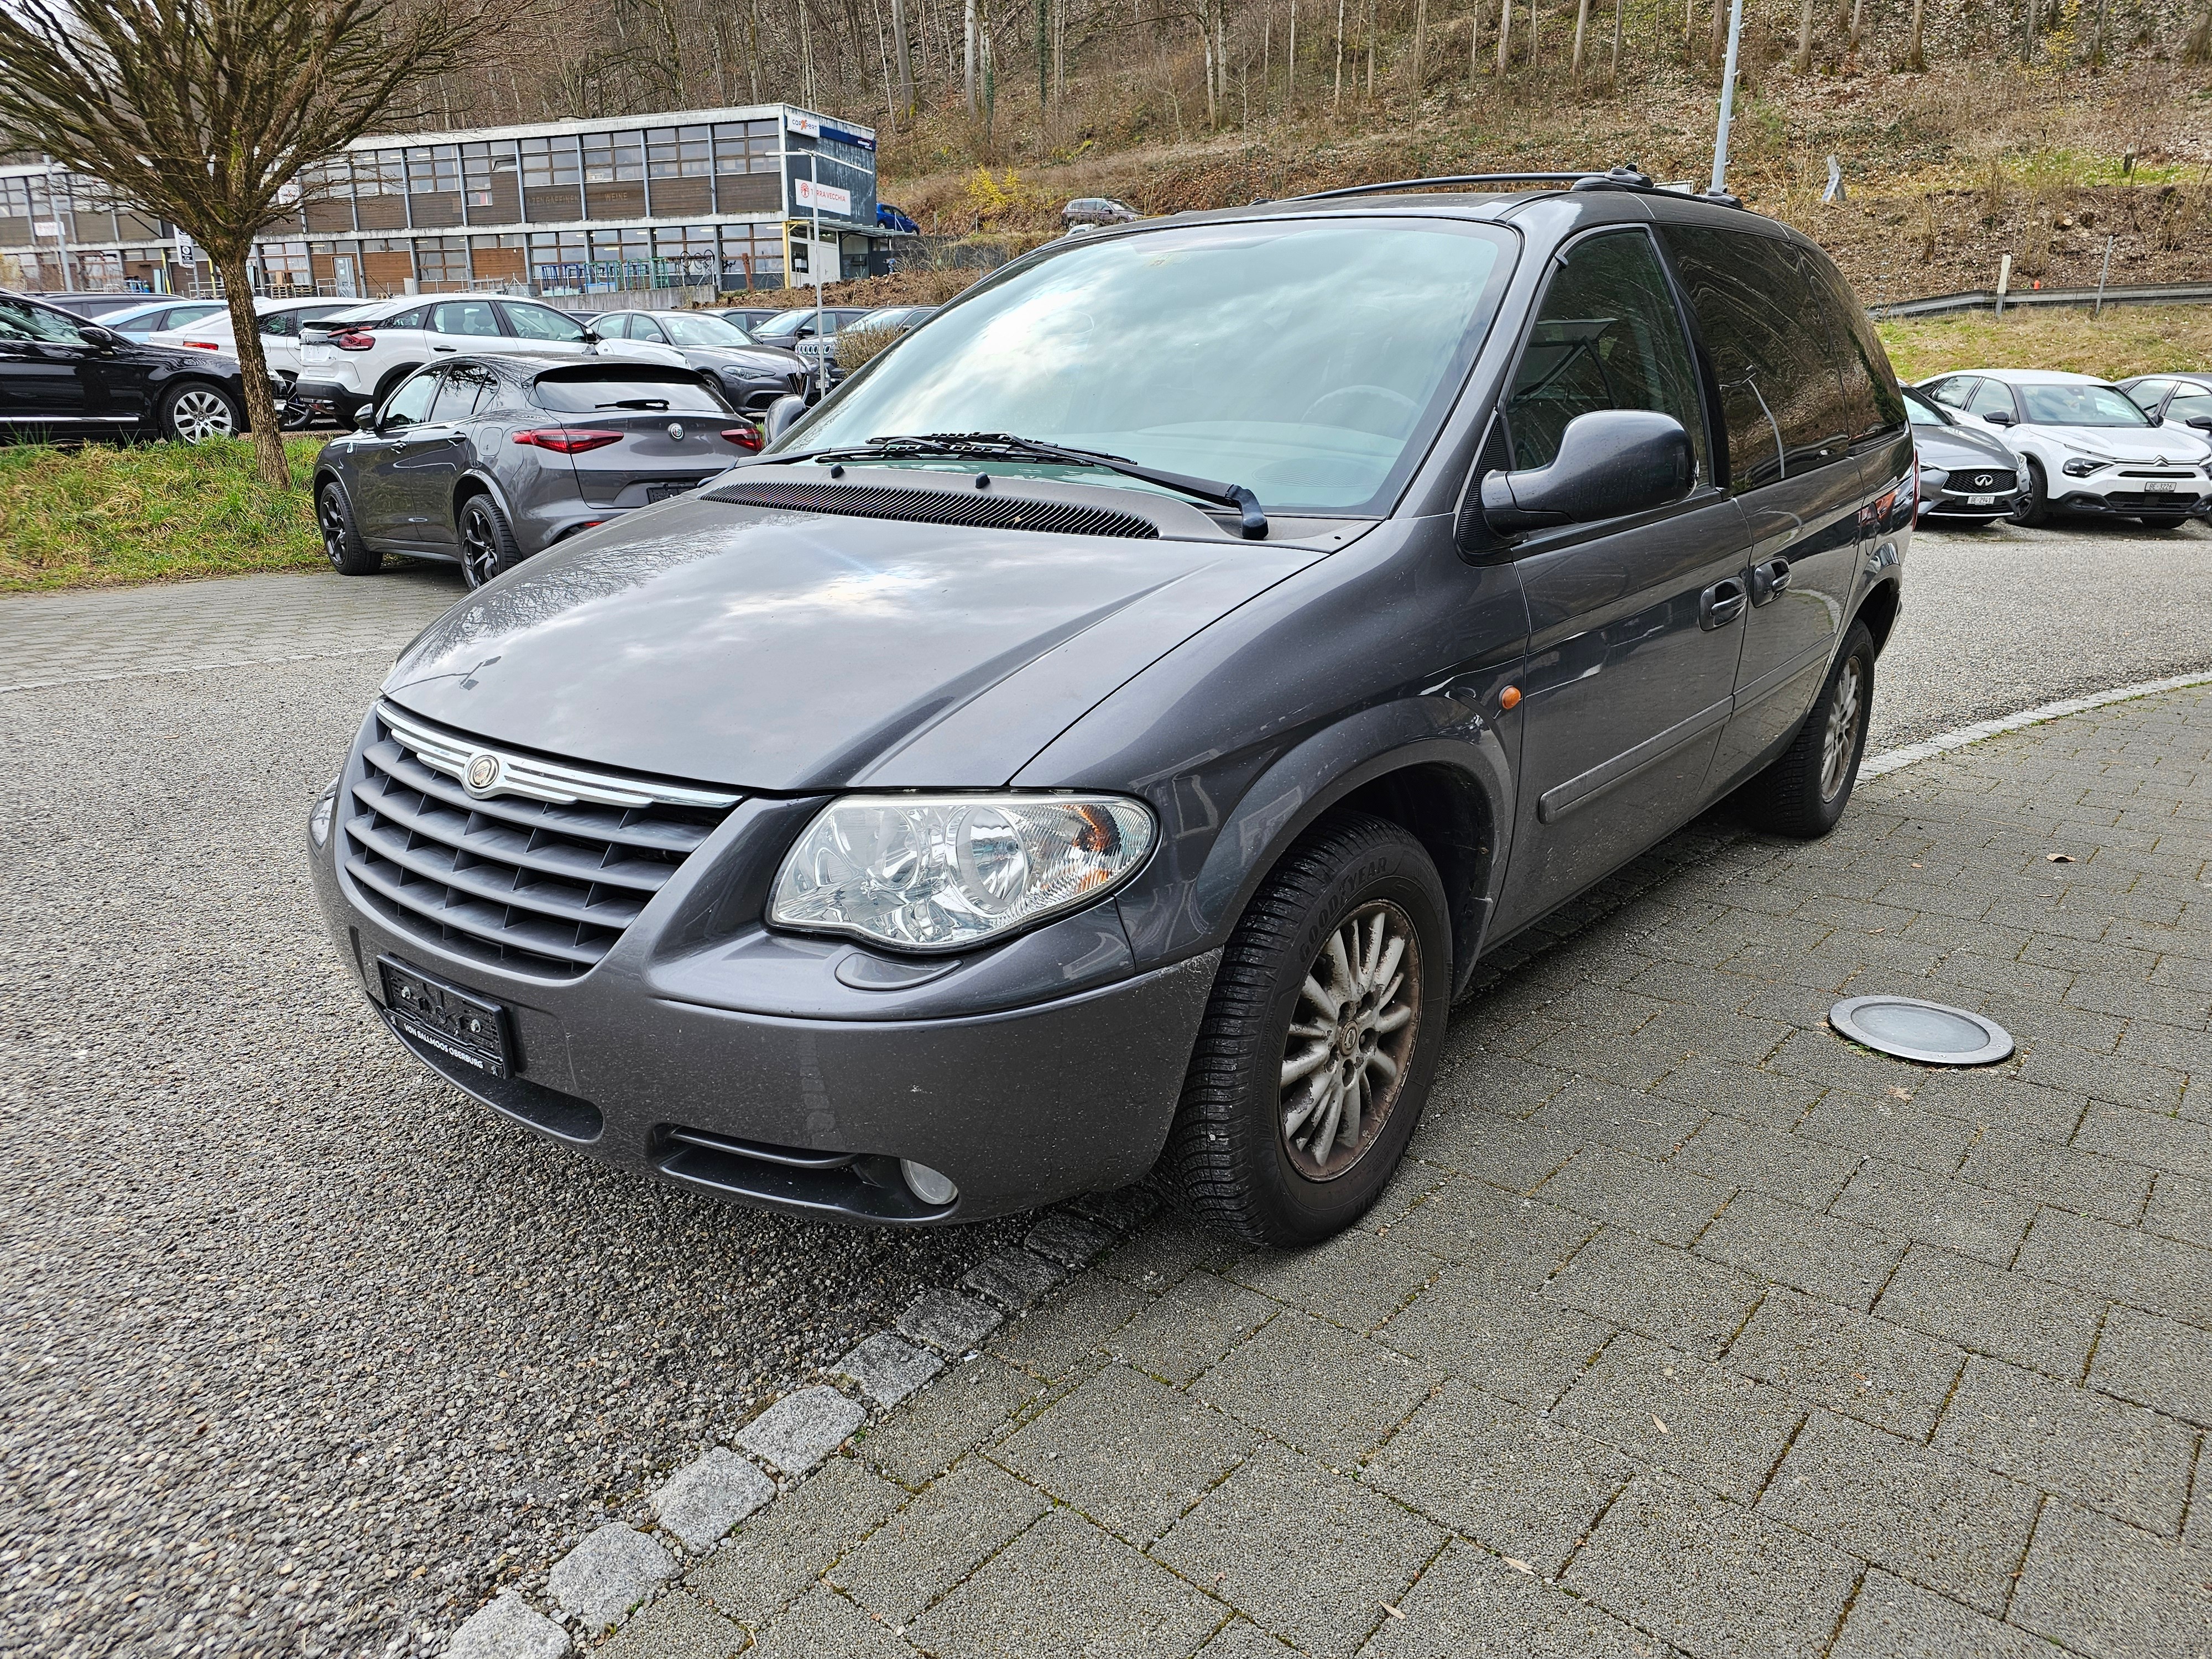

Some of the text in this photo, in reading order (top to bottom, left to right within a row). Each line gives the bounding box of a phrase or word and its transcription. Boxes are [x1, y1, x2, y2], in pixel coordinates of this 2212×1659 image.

[604, 192, 628, 201] WEINE
[810, 189, 846, 202] TRRA VECCHIA
[1300, 857, 1387, 963] GOODYEAR
[404, 1023, 484, 1069] VON BALLMOOS OBERBURG
